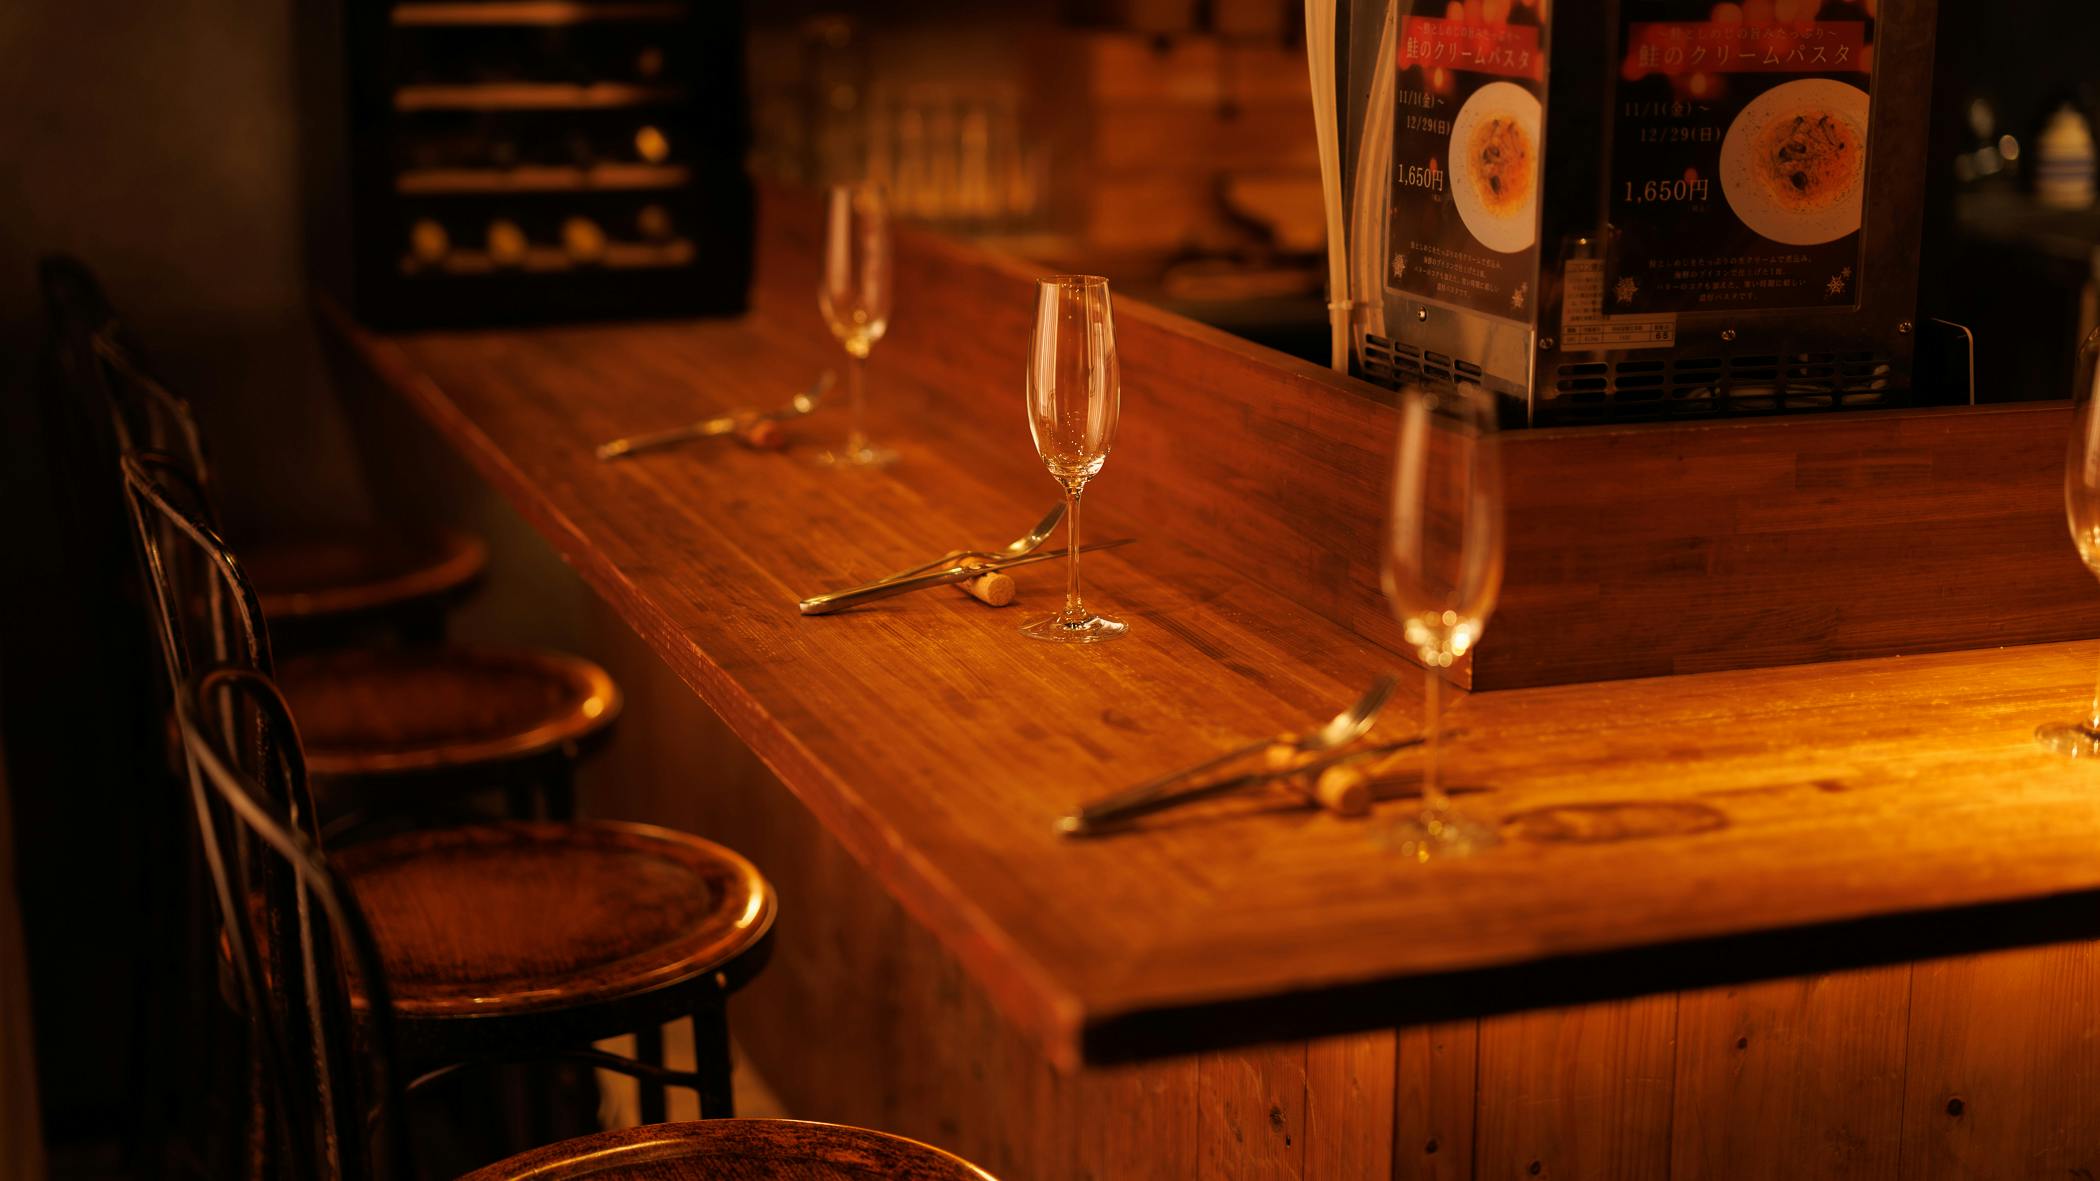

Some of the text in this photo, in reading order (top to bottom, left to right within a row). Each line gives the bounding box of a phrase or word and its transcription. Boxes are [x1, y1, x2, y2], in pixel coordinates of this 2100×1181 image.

[1406, 36, 1529, 70] 鮭のクリームパスタ
[1639, 43, 1850, 68] 鮭のクリームパスタ
[1407, 115, 1451, 137] 12/29(日)
[1640, 127, 1721, 143] 12/29(日)
[1398, 163, 1444, 192] 1,650円
[1624, 179, 1709, 204] 1,650円
